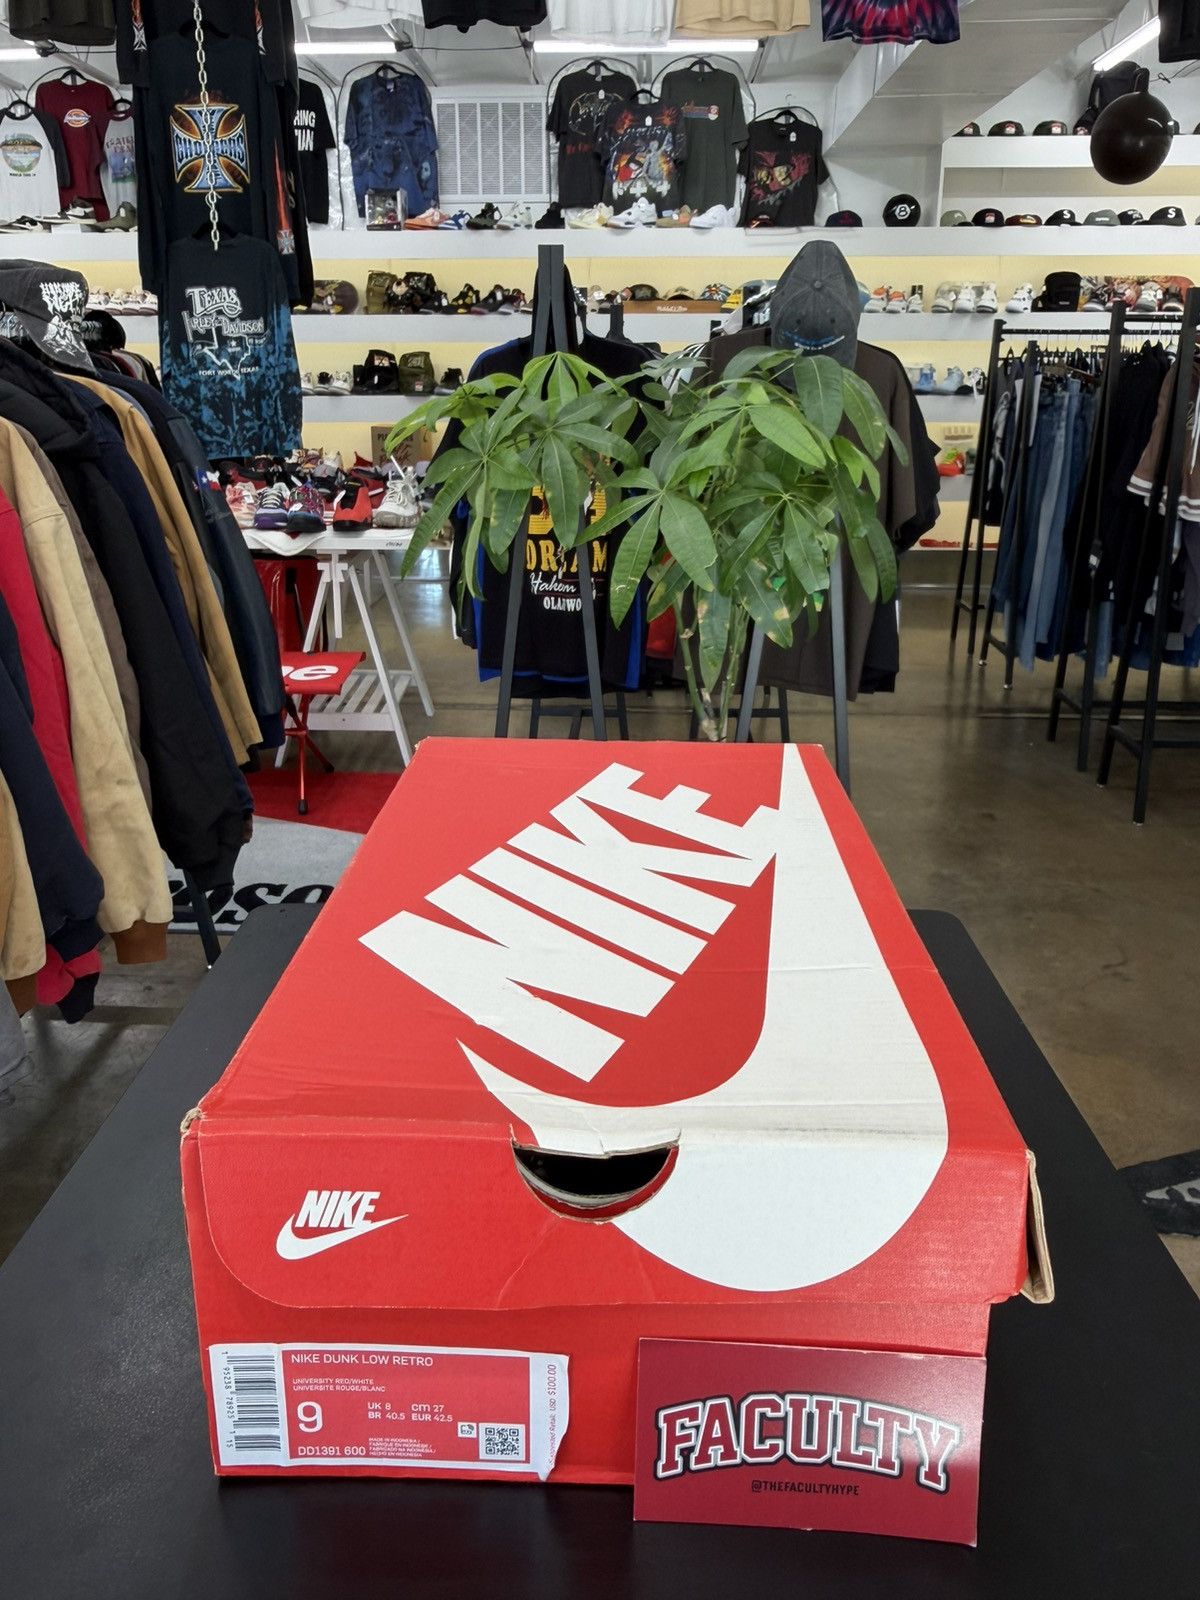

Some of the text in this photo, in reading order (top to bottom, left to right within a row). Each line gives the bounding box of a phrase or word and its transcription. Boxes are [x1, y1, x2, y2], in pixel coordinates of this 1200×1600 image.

[358, 761, 779, 1083] NIKE
[295, 1189, 381, 1229] NIKE
[291, 1353, 434, 1367] NIKE DUNK LOW RETRO
[292, 1377, 334, 1385] UNIVERSITY
[547, 1364, 557, 1396] $100.00
[335, 1385, 386, 1393] ROUGE/BLANC
[368, 1402, 382, 1411] UK
[384, 1402, 392, 1411] 8
[433, 1404, 444, 1413] 27
[297, 1401, 323, 1433] 9
[368, 1411, 453, 1423] BR 40.5 EUR 42.5
[298, 1445, 366, 1456] DD1391 600
[655, 1392, 962, 1494] FACULTY
[751, 1480, 860, 1497] @THEFACULTYHYPE
